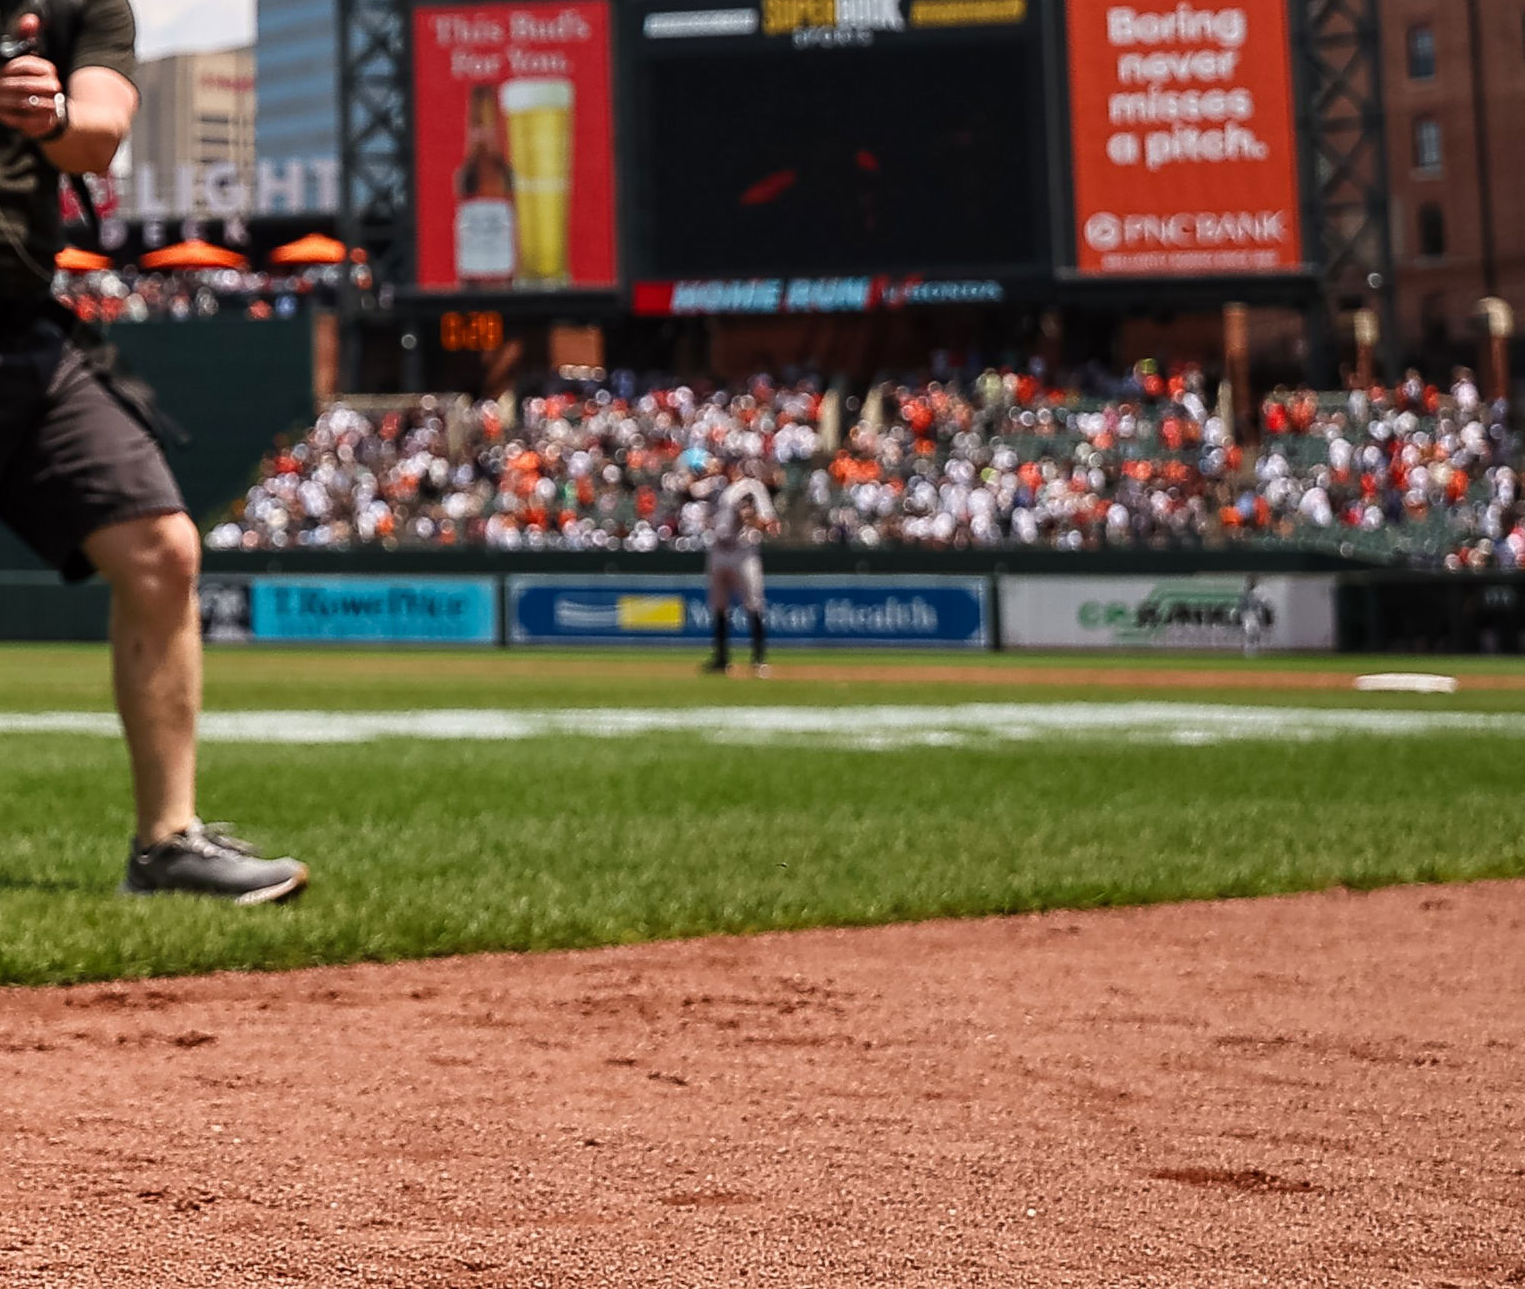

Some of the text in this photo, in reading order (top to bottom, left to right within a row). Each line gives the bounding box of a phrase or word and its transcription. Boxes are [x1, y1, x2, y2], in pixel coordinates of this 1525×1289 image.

[1106, 3, 1247, 47] Boring
[1117, 50, 1240, 84] never
[1108, 84, 1254, 125] misses
[1106, 120, 1269, 172] a pitch.
[136, 161, 342, 217] LIGHT
[671, 278, 783, 314] HOME
[787, 276, 870, 312] RUN
